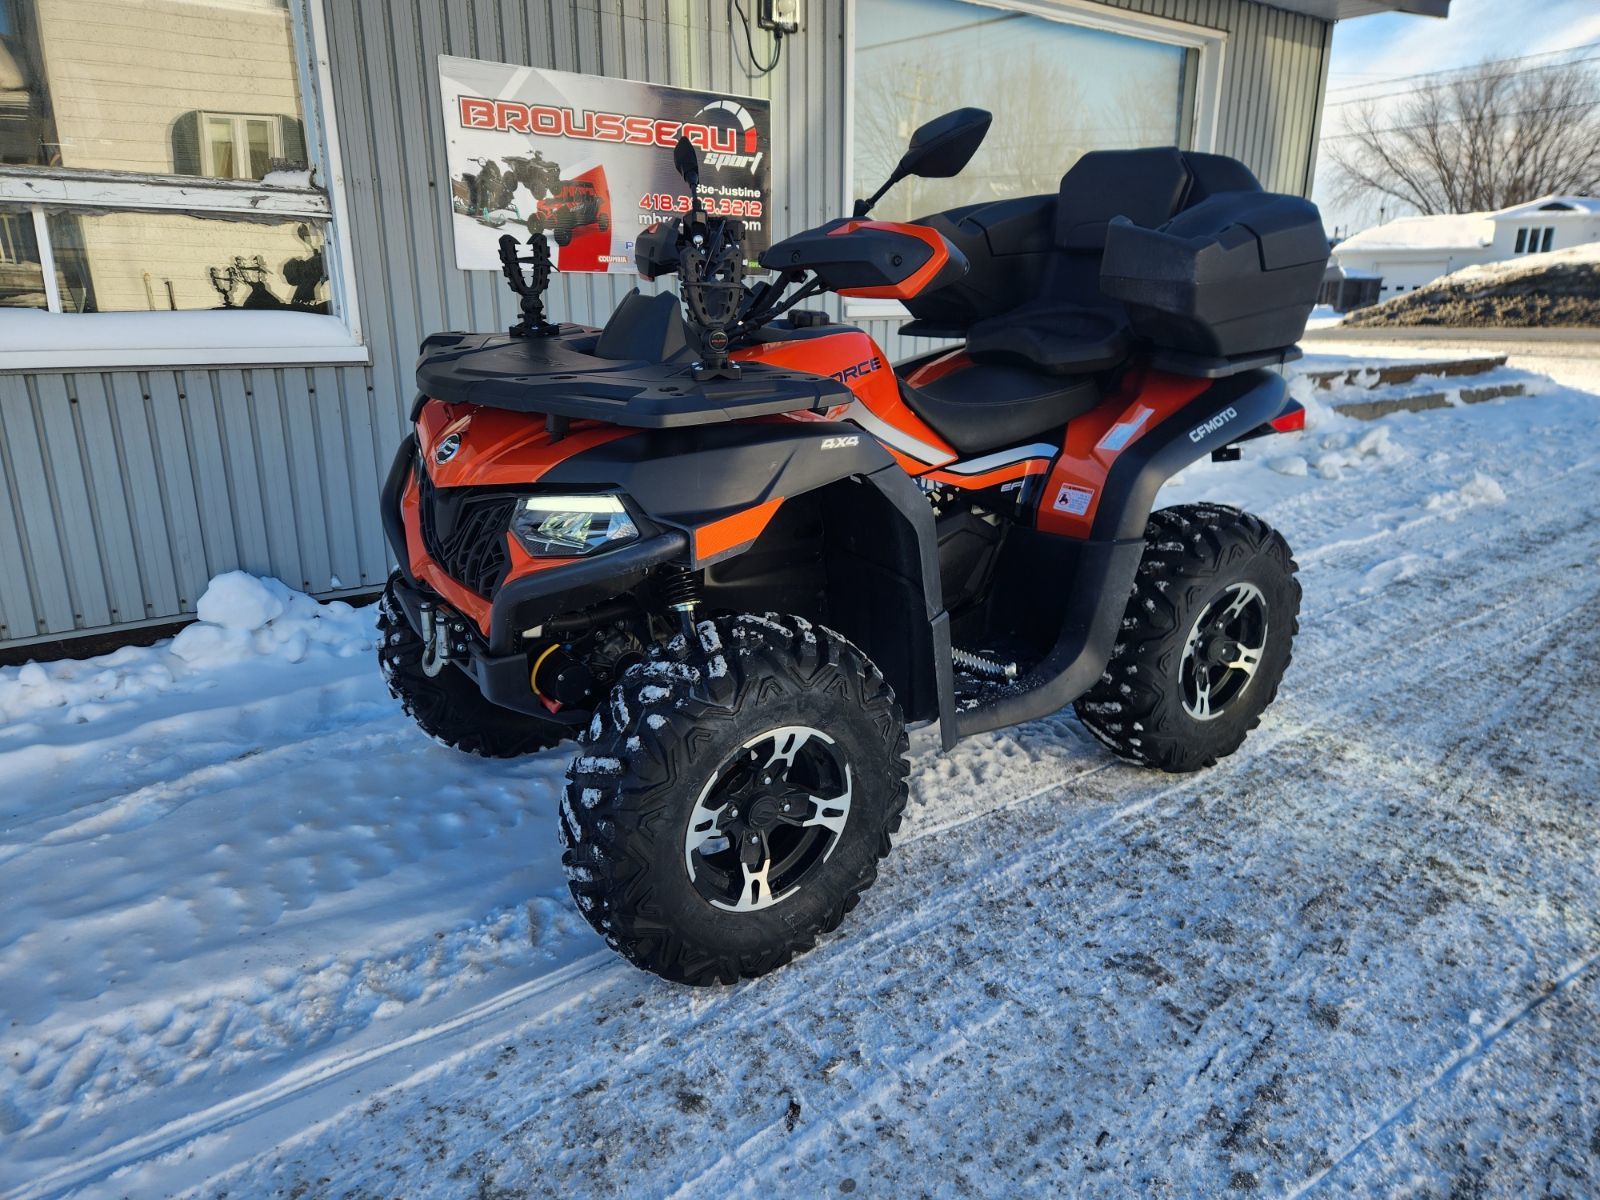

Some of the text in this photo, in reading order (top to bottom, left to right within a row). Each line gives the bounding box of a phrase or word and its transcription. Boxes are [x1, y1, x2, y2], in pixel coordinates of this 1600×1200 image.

[458, 95, 737, 154] BROUSSEAU
[703, 152, 763, 175] sport
[639, 193, 762, 217] 418.33.3212
[1188, 406, 1238, 443] CFMOTO
